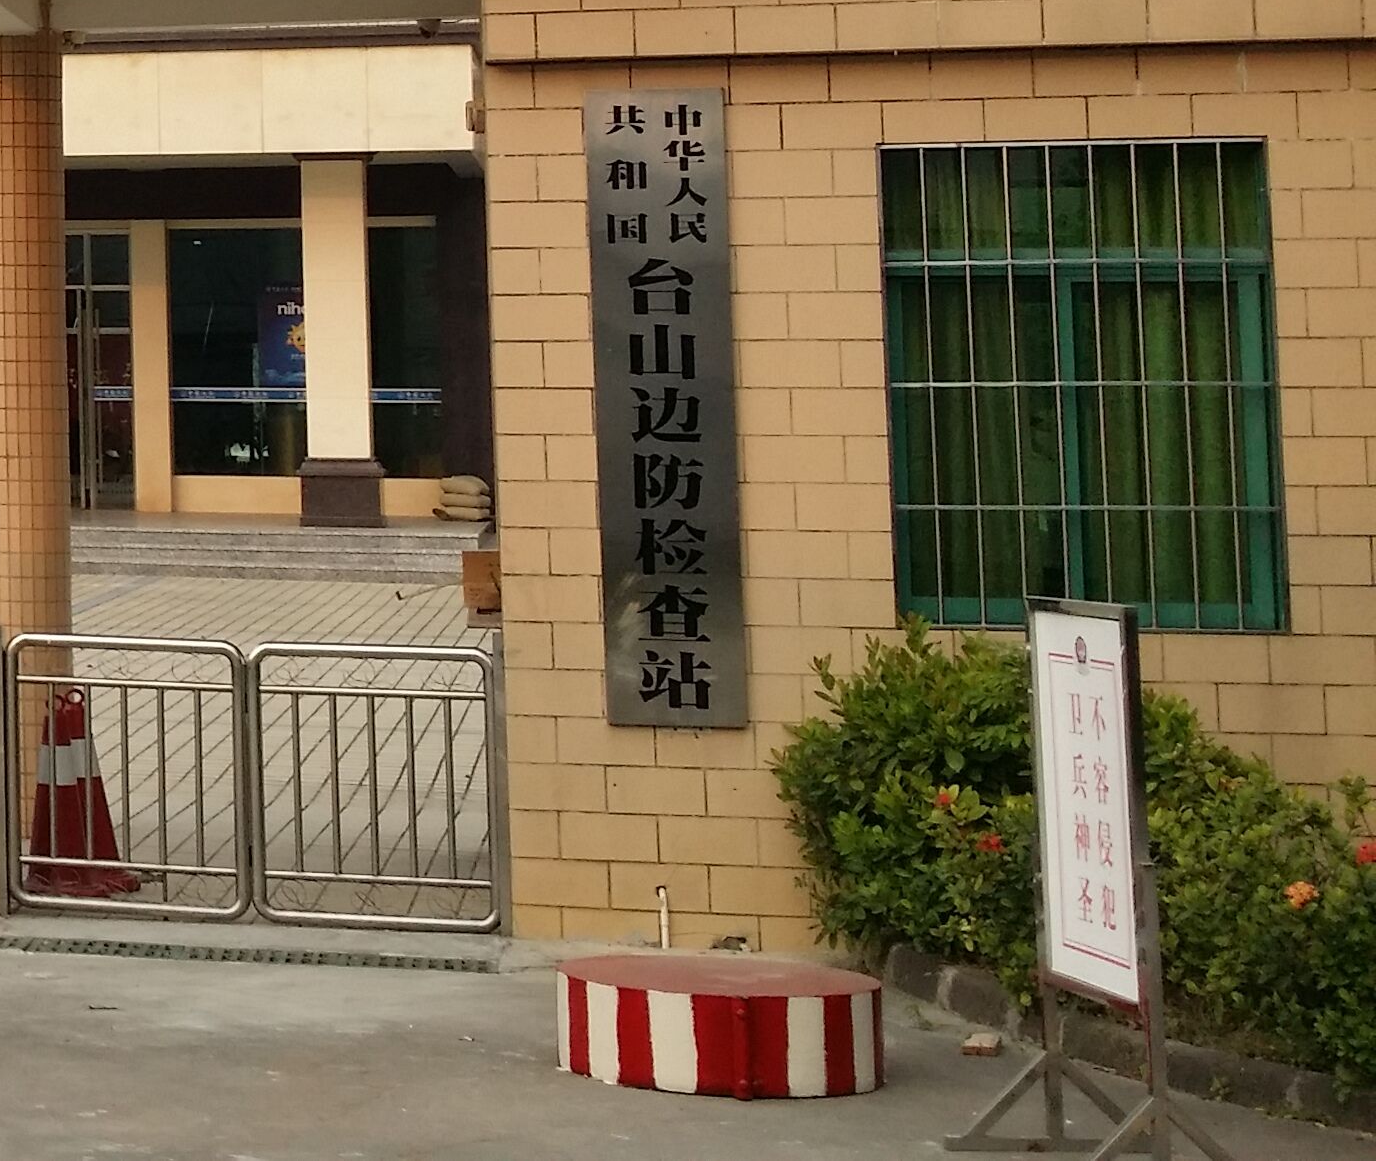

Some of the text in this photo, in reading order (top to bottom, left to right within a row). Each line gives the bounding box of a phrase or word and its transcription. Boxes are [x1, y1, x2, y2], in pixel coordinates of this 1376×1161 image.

[605, 104, 648, 244] 共和国
[664, 104, 708, 244] 中华人民
[277, 301, 305, 315] nih
[627, 258, 712, 710] 台山边防检查站
[1067, 691, 1094, 925] 卫兵神圣
[1088, 694, 1117, 932] 不容侵犯
